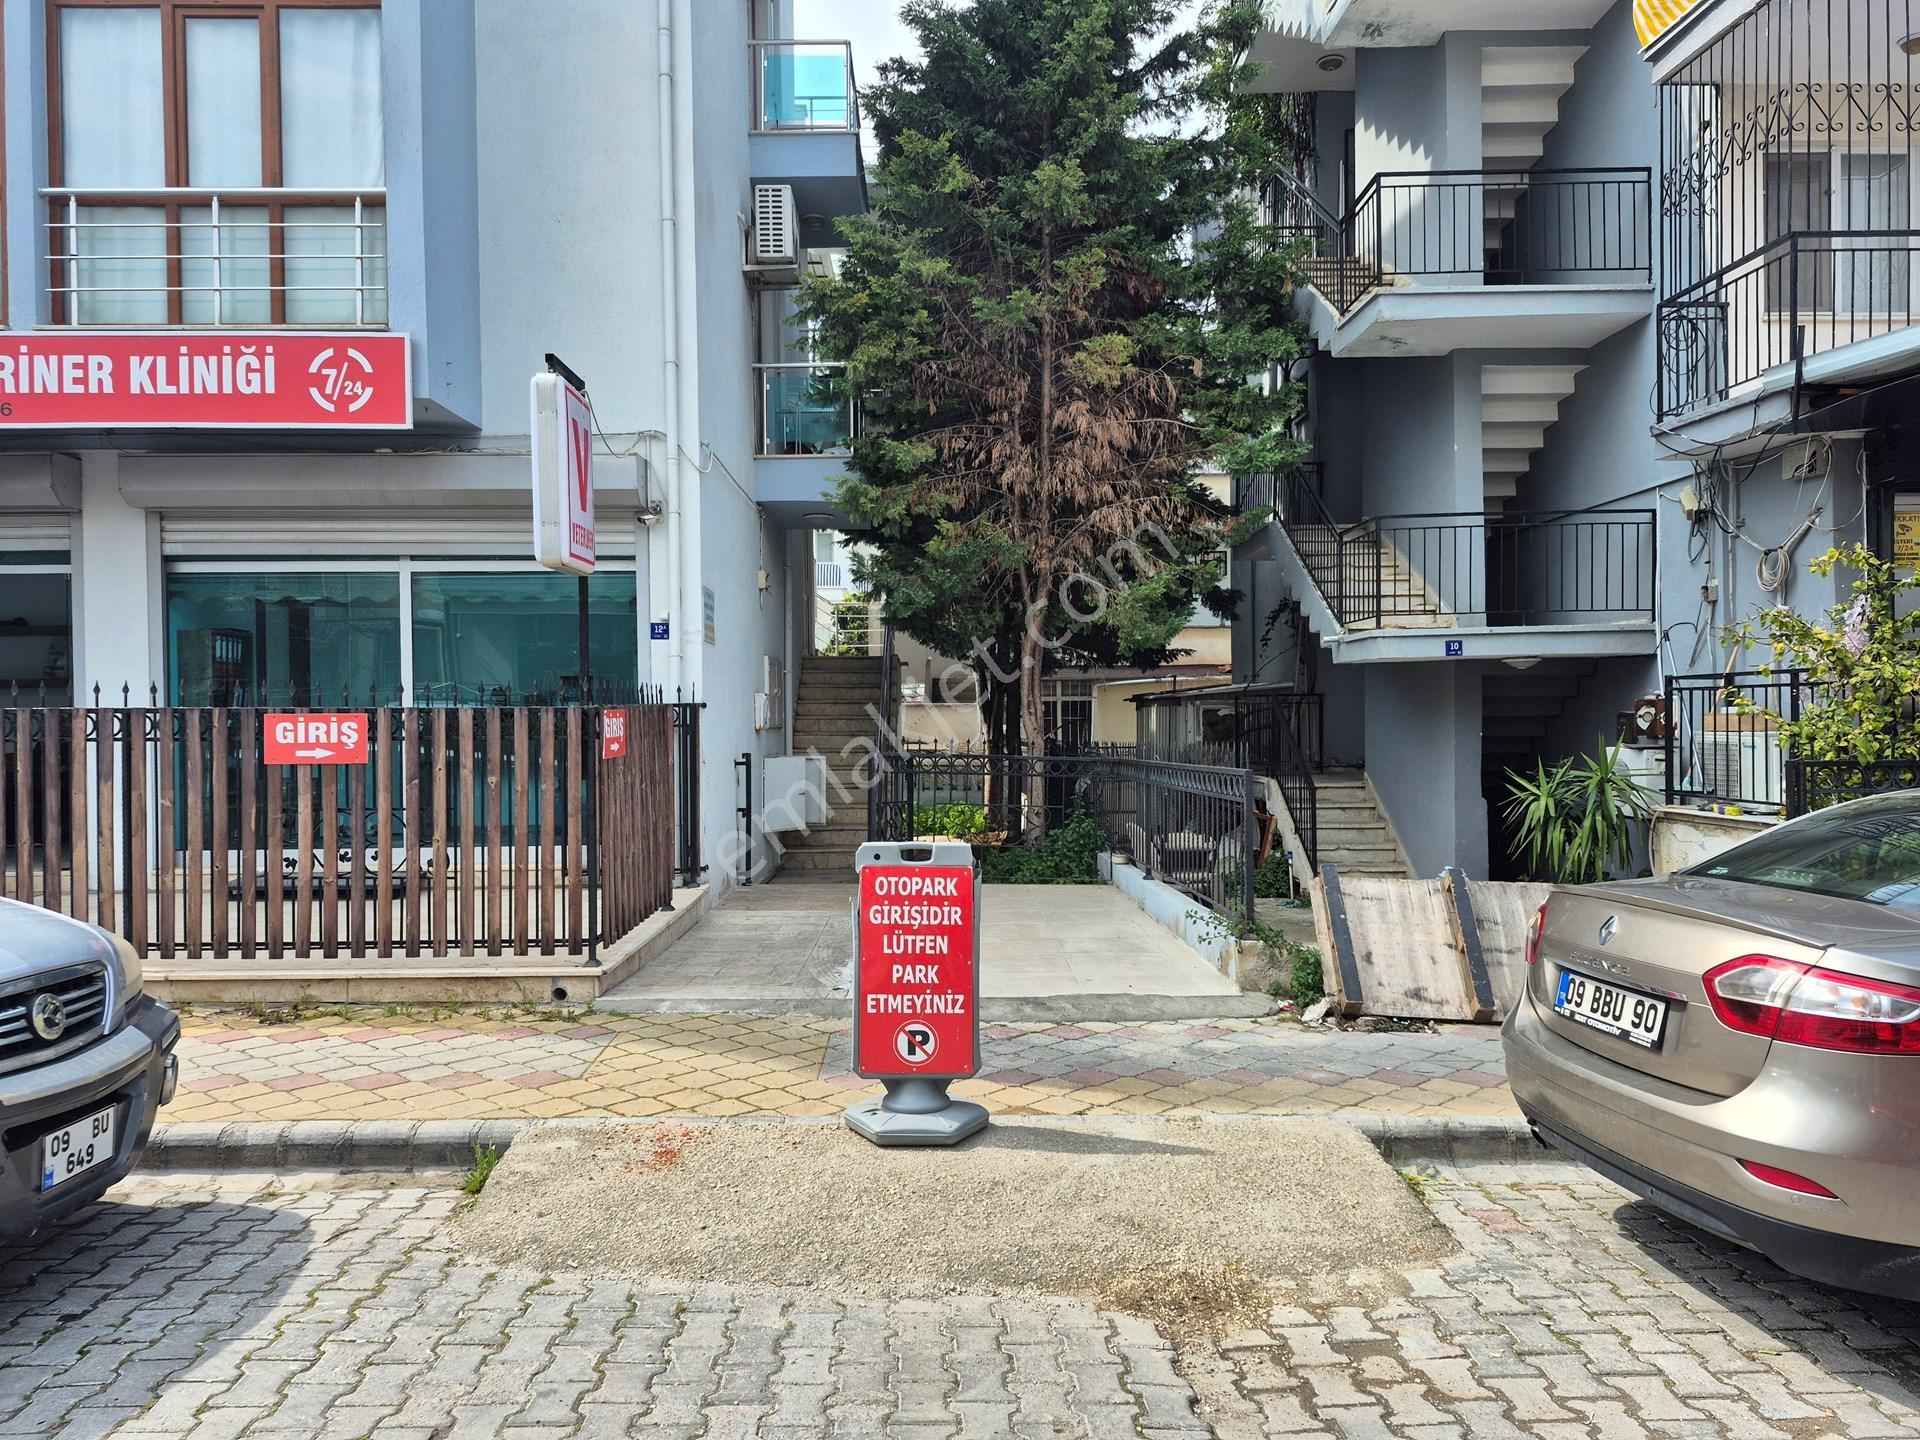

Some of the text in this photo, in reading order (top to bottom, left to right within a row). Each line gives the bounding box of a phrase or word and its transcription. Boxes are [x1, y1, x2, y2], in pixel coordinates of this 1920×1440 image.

[130, 345, 276, 395] KLİNİĞİ
[321, 361, 363, 401] 7/24
[572, 416, 589, 513] V
[1450, 642, 1459, 650] 10
[275, 716, 359, 749] GİRİŞ
[605, 714, 625, 744] GİRİŞ
[874, 876, 958, 897] OTOPARK
[869, 900, 963, 930] GİRİŞİDİR
[883, 930, 948, 955] LÜTFEN
[892, 964, 939, 984] PARK
[866, 989, 965, 1014] ETMEYİNİZ
[1565, 977, 1659, 1033] 09 BBU 90
[907, 1029, 931, 1056] P
[51, 1112, 110, 1157] 09 BU
[66, 1143, 95, 1174] 649
